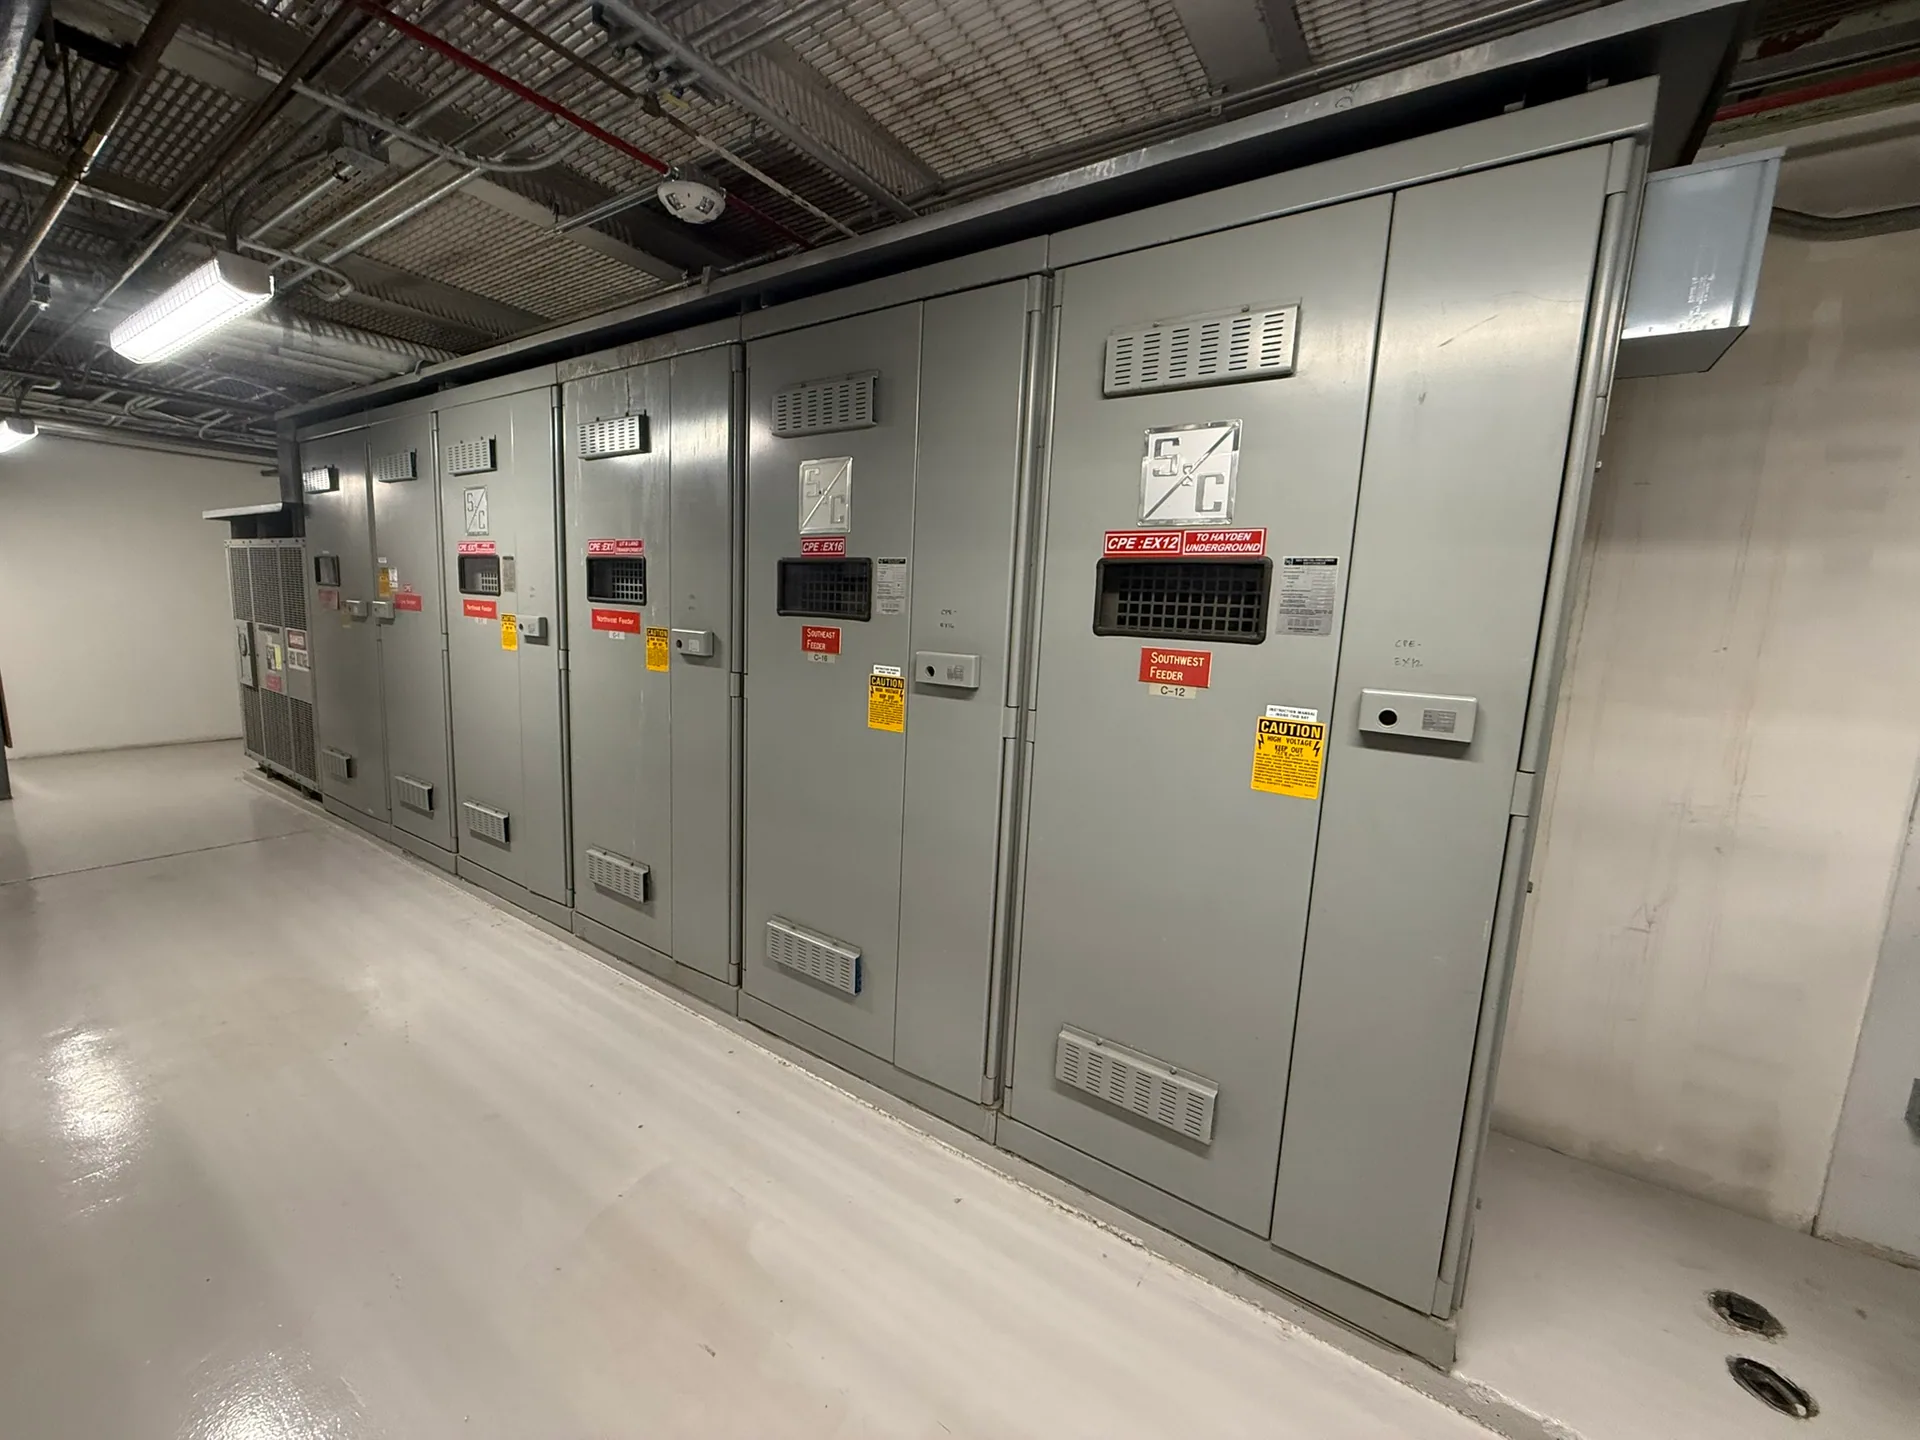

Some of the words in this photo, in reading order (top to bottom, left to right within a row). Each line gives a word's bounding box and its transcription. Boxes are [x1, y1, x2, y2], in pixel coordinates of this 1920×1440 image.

[1196, 533, 1209, 542] TO
[1210, 532, 1252, 542] HAYDEN
[802, 542, 819, 552] CPE
[1107, 537, 1136, 550] CPE
[1138, 536, 1179, 550] :EX12
[1185, 543, 1261, 552] UNDERGROUND
[618, 616, 635, 625] Feeder
[806, 628, 836, 639] SOUTHEAST
[806, 639, 826, 650] FEEDER
[1150, 651, 1205, 667] SOUTHWEST
[1149, 666, 1183, 681] FEEDER
[871, 676, 903, 689] CAUTION
[1160, 685, 1186, 697] C-12
[1260, 720, 1321, 739] CAUTION
[1267, 735, 1282, 743] HIGH
[1286, 737, 1313, 747] VOLTAGE
[1274, 744, 1288, 753] KEEP
[1290, 746, 1304, 754] OUT
